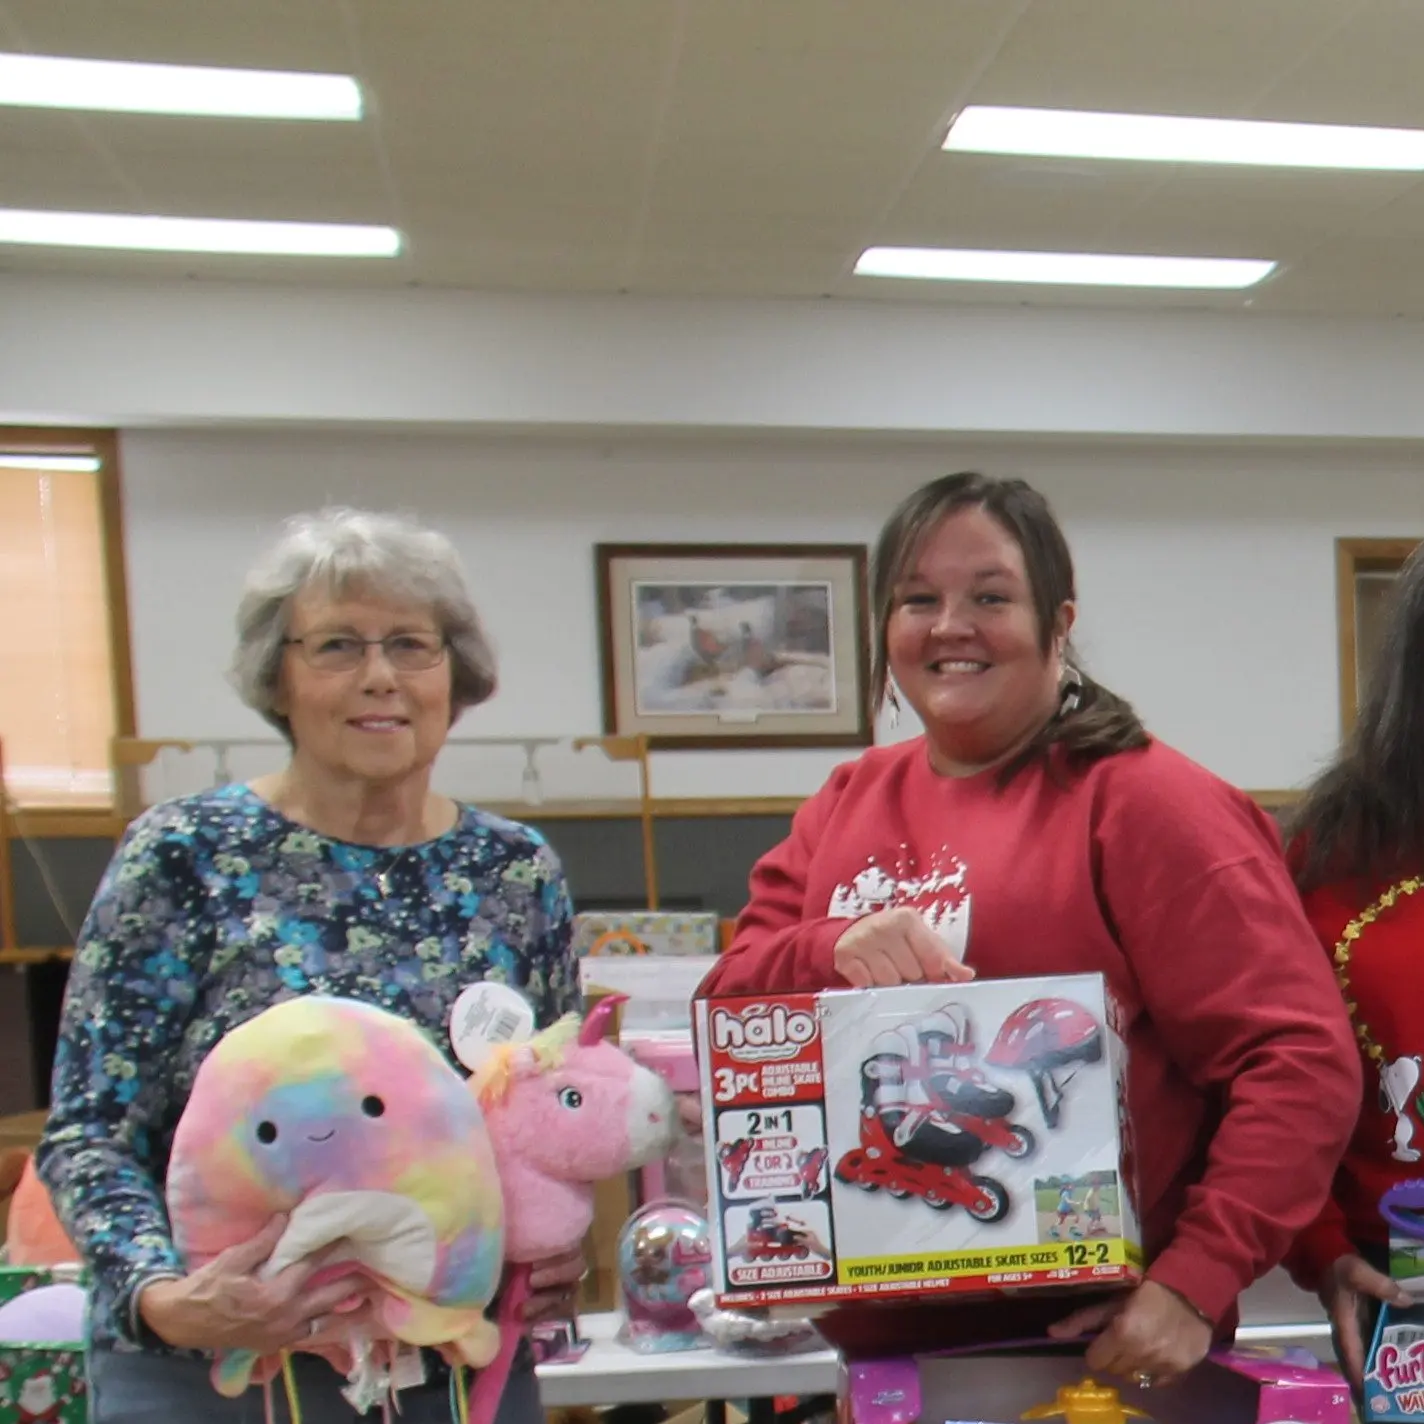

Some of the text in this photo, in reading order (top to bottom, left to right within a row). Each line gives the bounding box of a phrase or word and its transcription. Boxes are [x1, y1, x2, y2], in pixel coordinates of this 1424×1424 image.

[711, 1006, 817, 1051] halo
[747, 1110, 793, 1135] 2 IN 1
[764, 1156, 782, 1170] OR
[927, 1256, 992, 1274] ADJUSTABLE
[994, 1253, 1027, 1267] SKATE
[1030, 1250, 1059, 1265] SIZES
[1063, 1243, 1110, 1266] 12-2
[736, 1263, 824, 1281] SIZE ADJUSTABLE
